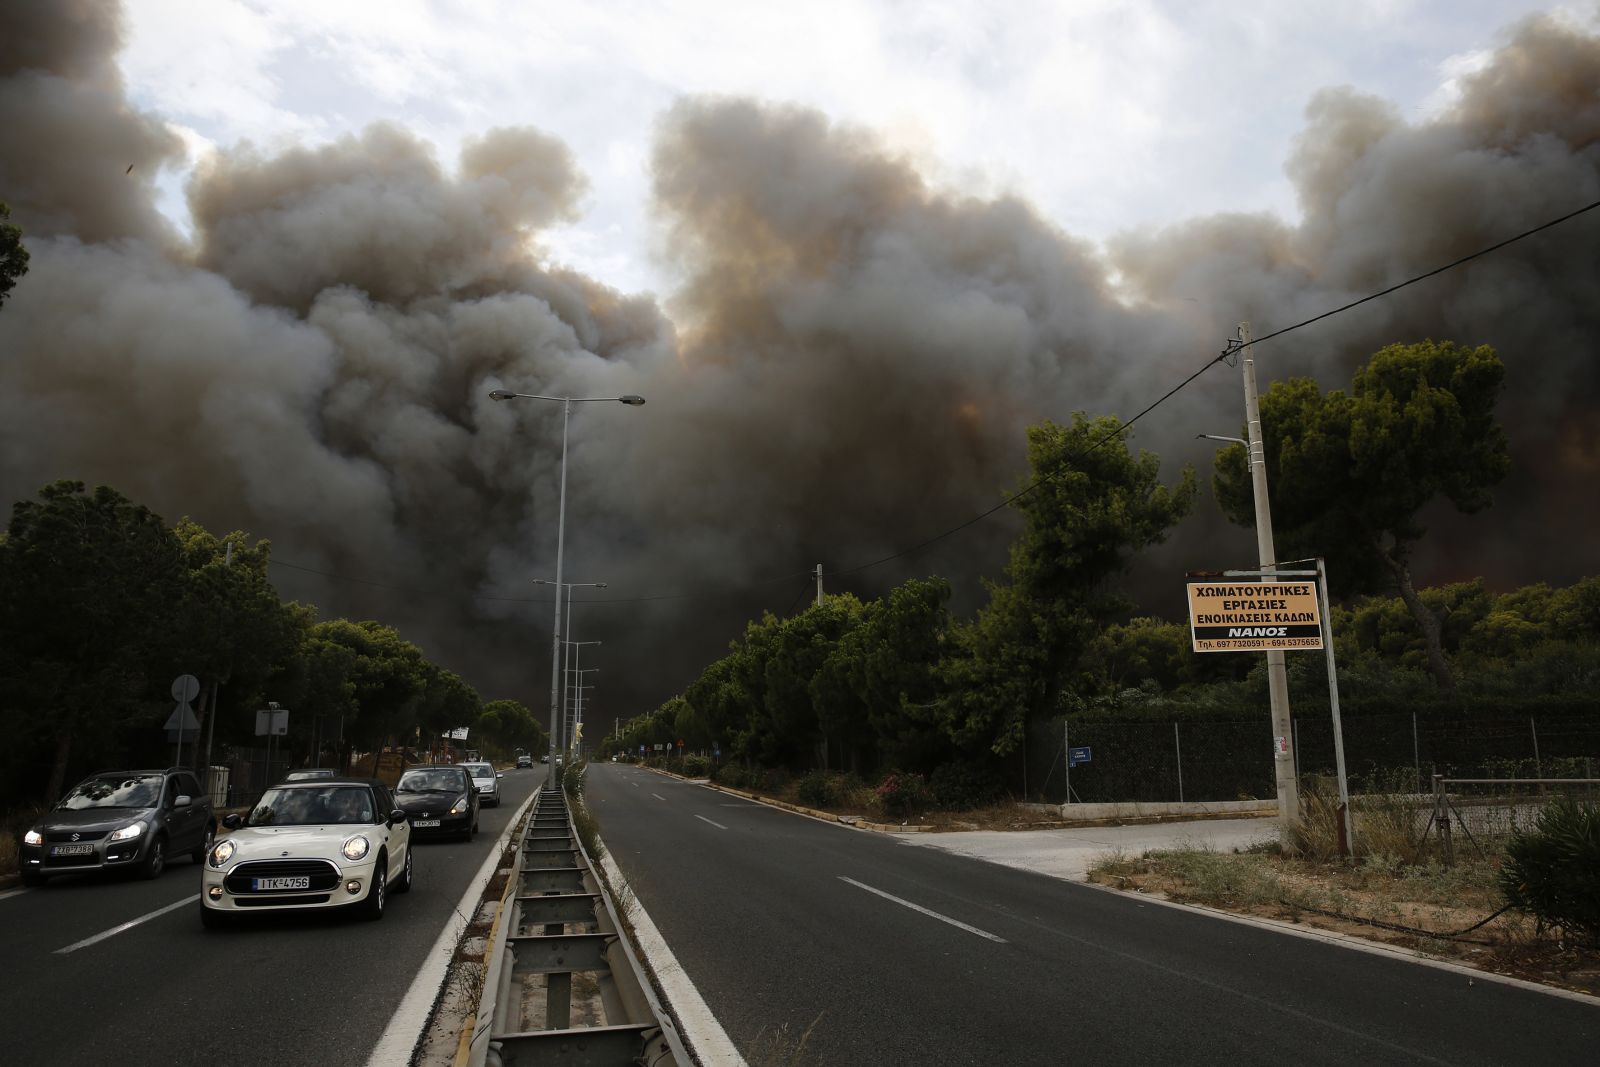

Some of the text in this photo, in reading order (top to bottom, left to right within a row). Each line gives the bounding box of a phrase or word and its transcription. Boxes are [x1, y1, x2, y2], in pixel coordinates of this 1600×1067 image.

[1196, 585, 1310, 597] ΧΩΜΑΤΟΥΡΓΙΚΕΣ
[1223, 599, 1287, 610] ΕΡΓΑΣΙΕΣ
[1197, 612, 1314, 624] ΕΝΟΙΚΙΑΣΕΙΣ ΚΑΔΩΝ
[1228, 627, 1288, 637] ΝΑΝΟΣ
[1198, 640, 1215, 649] Τηλ.
[1216, 640, 1231, 648] 697
[1233, 639, 1265, 647] 7320591
[1271, 639, 1285, 647] 694
[1287, 638, 1320, 646] 5375655
